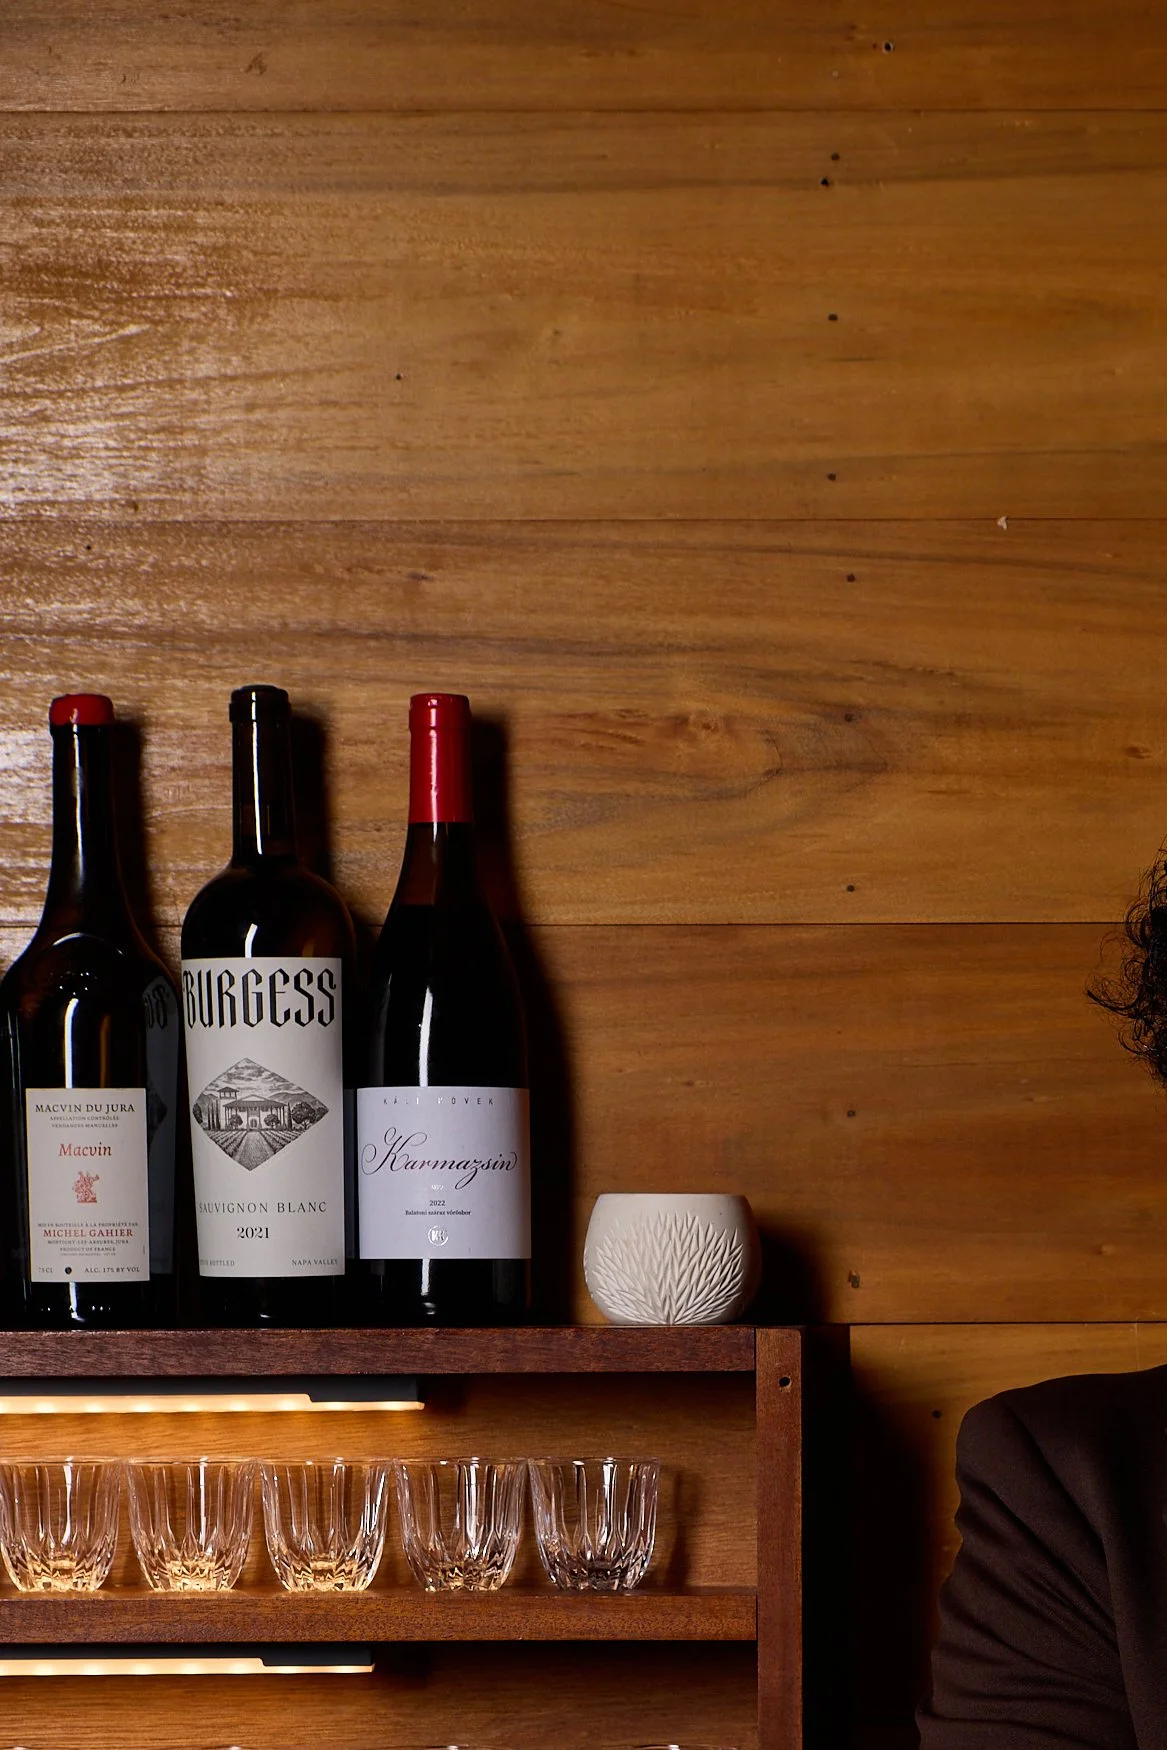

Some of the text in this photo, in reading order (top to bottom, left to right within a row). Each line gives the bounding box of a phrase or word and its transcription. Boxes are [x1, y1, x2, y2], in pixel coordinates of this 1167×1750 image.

[183, 968, 337, 1029] BURGESS
[35, 1103, 135, 1114] MACVIN DU JURA
[59, 1142, 112, 1157] Macvin
[361, 1127, 518, 1190] Karmazsin
[200, 1202, 327, 1213] SAUVIGNON BLANC
[43, 1229, 133, 1237] MICHEL GAHIER
[236, 1227, 270, 1239] 2021
